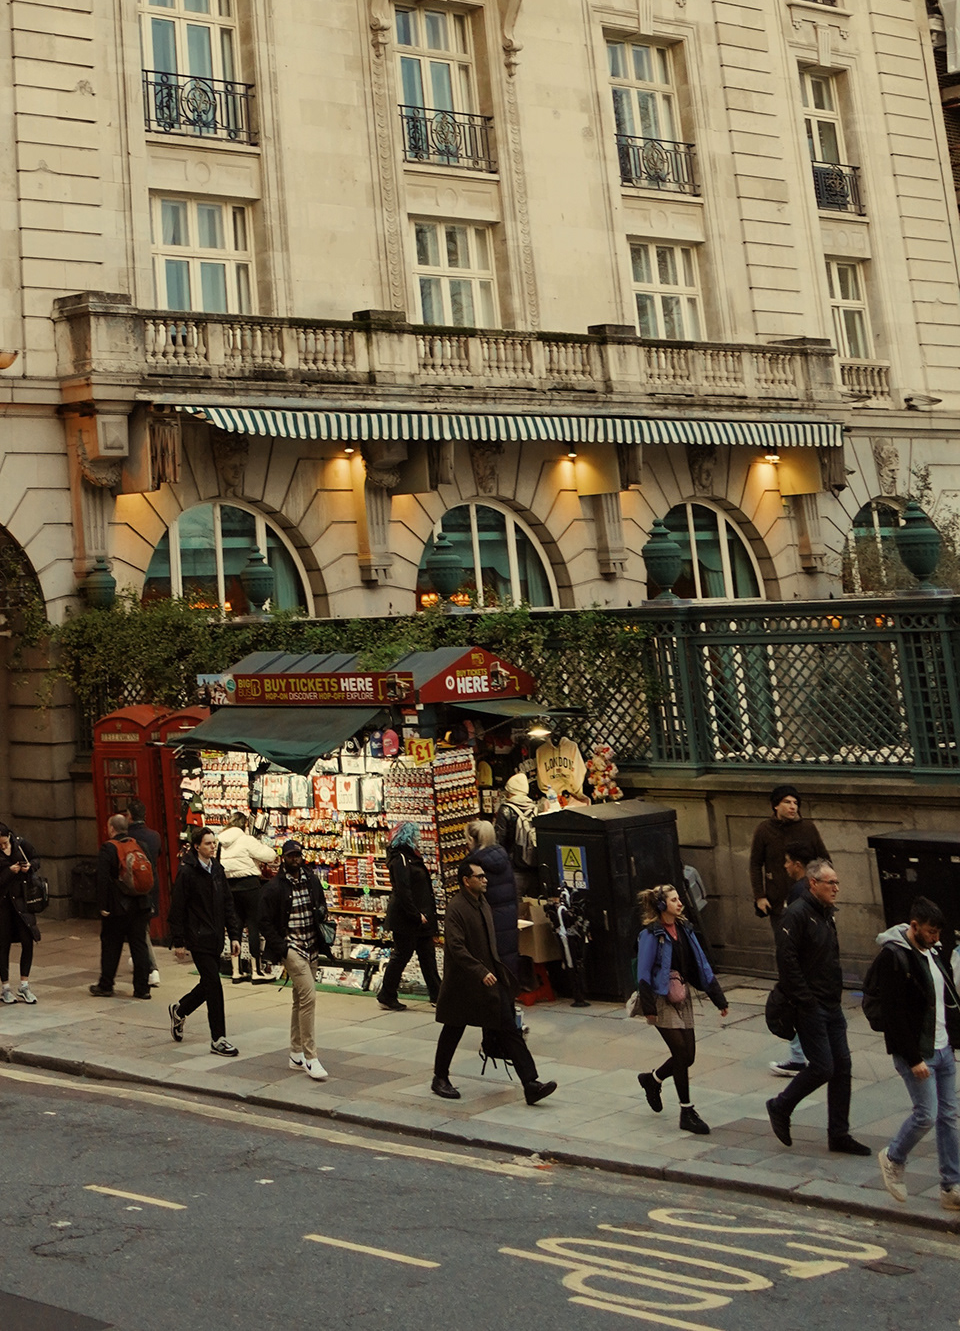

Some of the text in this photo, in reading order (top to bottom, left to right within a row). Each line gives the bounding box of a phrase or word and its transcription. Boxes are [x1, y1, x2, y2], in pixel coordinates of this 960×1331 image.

[466, 668, 488, 676] TICKETS
[238, 678, 251, 688] BIG
[264, 677, 374, 692] BUY TICKETS HERE
[456, 675, 490, 694] HERE
[238, 688, 251, 697] BUS
[265, 691, 374, 700] HOP-ON DISCOVER HOP-OFF EXPLORE
[415, 742, 432, 762] £1
[544, 756, 574, 772] LONDON
[498, 1207, 888, 1312] STOP
